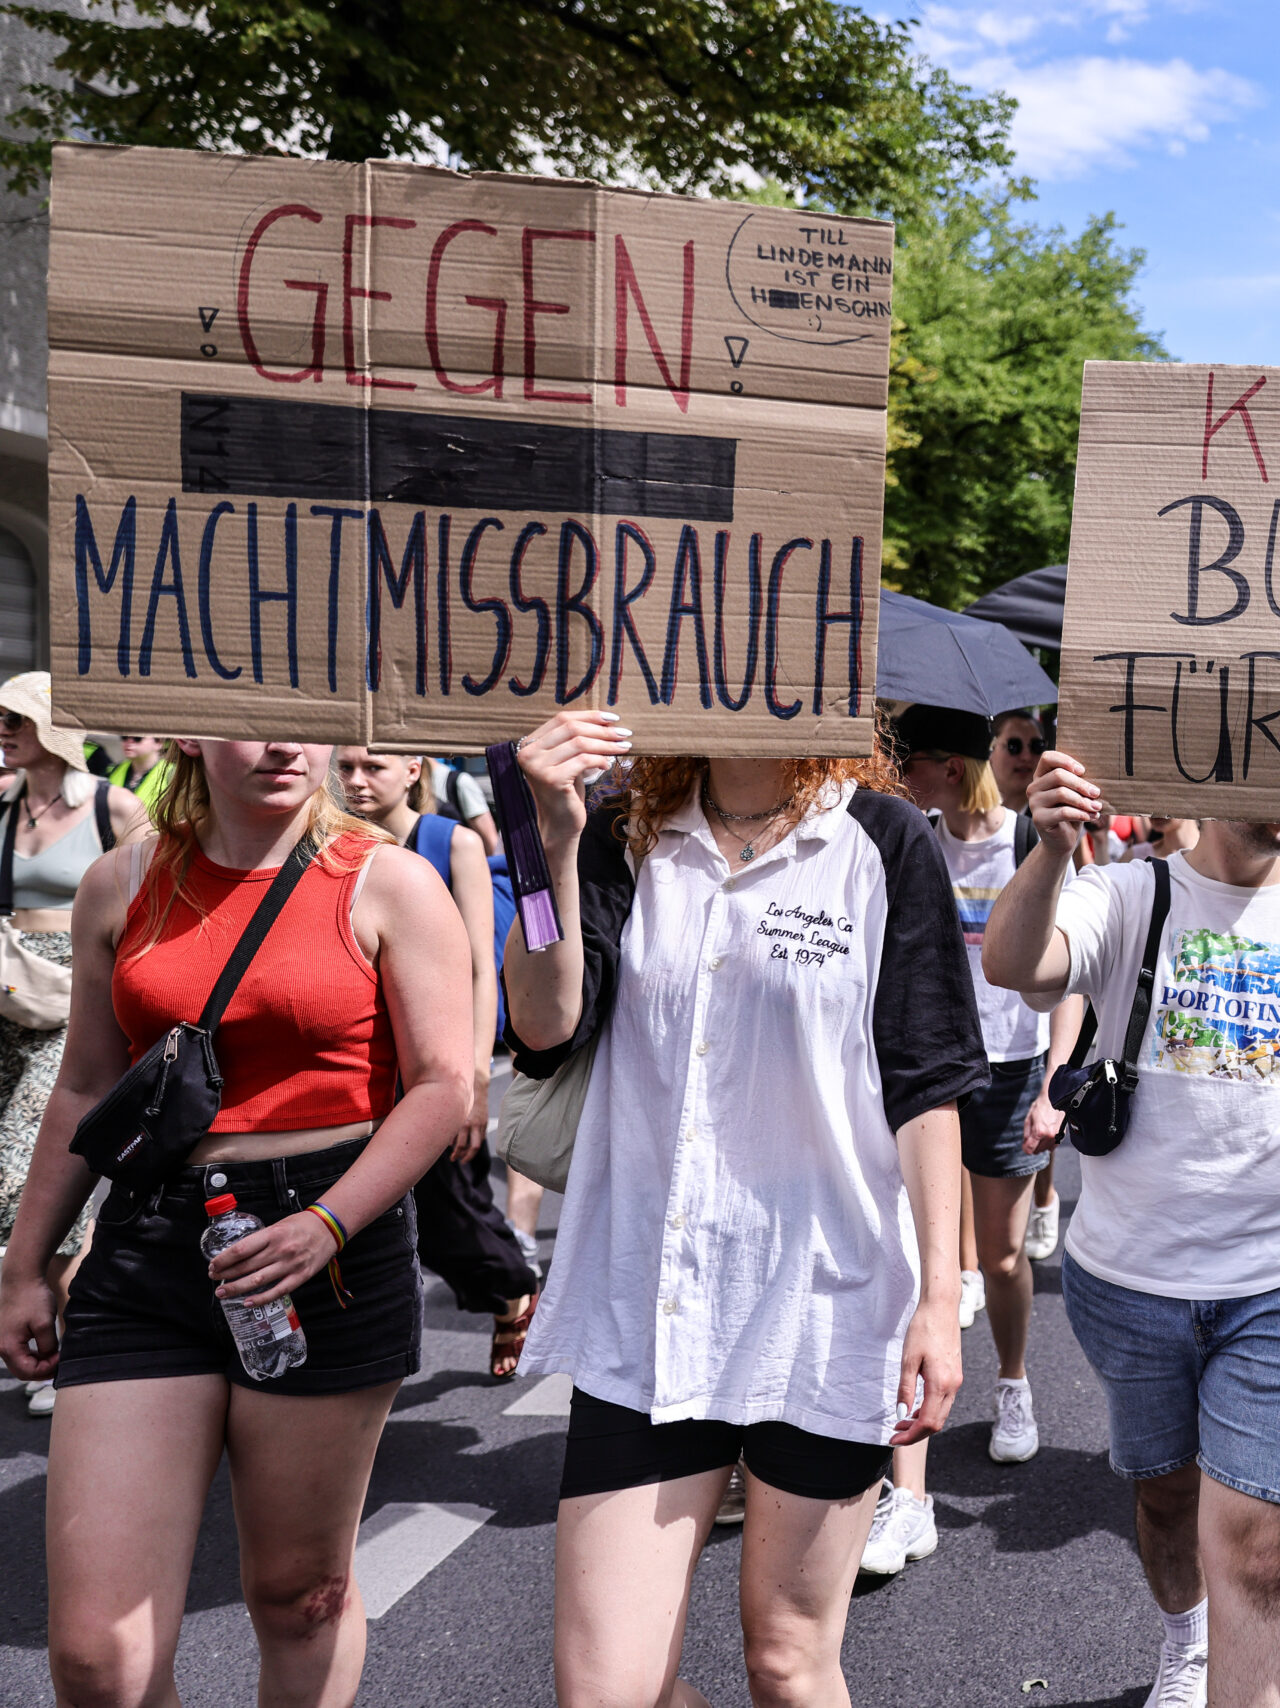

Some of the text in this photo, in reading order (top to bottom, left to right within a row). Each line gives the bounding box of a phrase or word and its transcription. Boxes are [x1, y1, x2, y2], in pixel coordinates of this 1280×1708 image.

[798, 227, 849, 246] TILL
[757, 243, 892, 275] LINDEMANN
[784, 269, 870, 293] IST EIN
[238, 204, 695, 413] GEGEN
[750, 285, 892, 318] HENSOHN
[75, 493, 865, 720] MACHTMISSBRAUCH
[757, 920, 850, 958] Summer League
[837, 916, 853, 933] Ca
[770, 943, 826, 969] Est 1974
